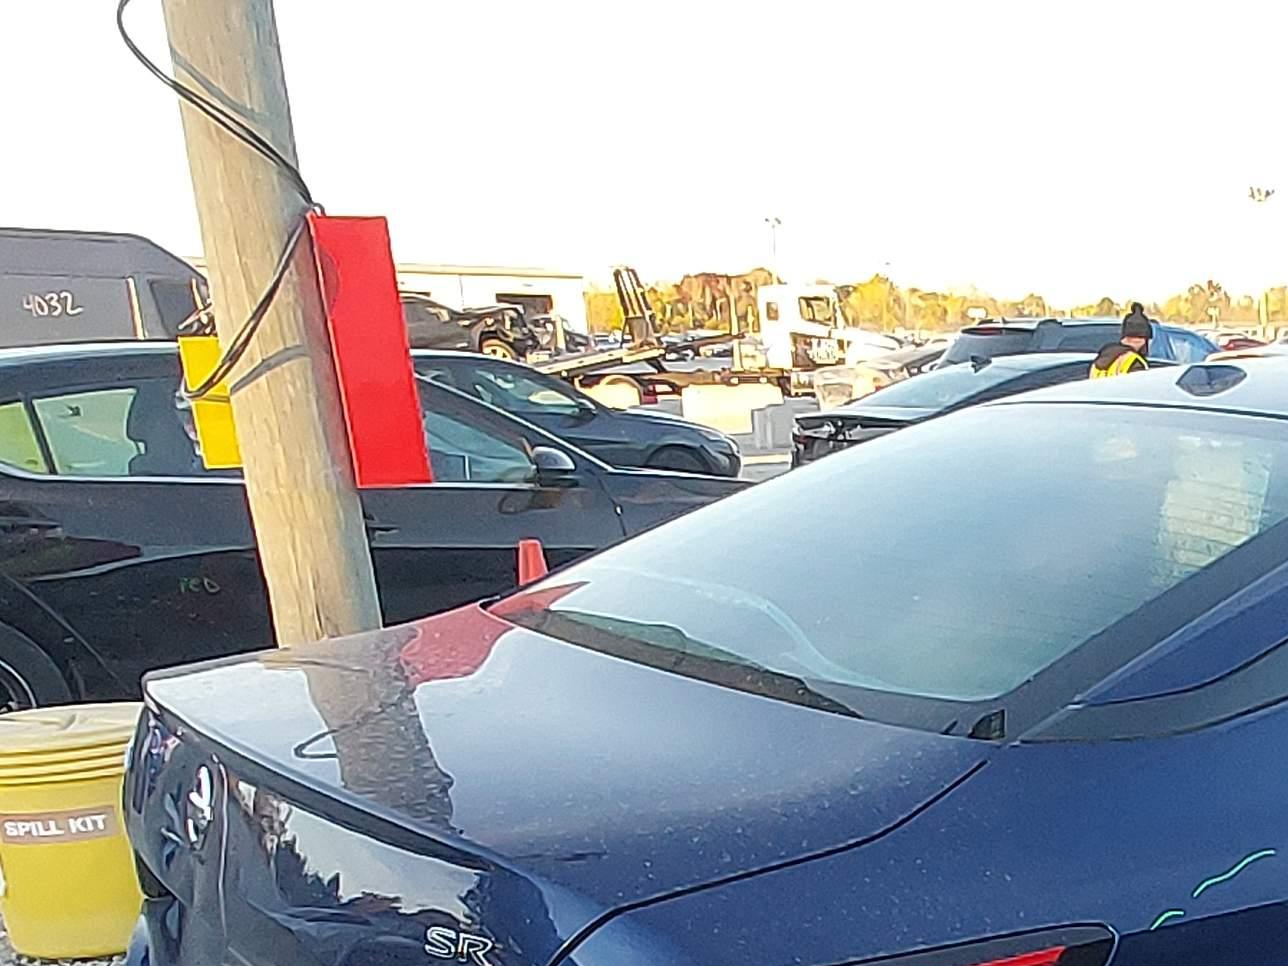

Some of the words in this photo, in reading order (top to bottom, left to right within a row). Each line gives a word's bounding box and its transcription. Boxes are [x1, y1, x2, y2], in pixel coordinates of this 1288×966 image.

[23, 291, 84, 317] 4032
[4, 821, 65, 837] SPILL
[68, 814, 107, 834] KIT
